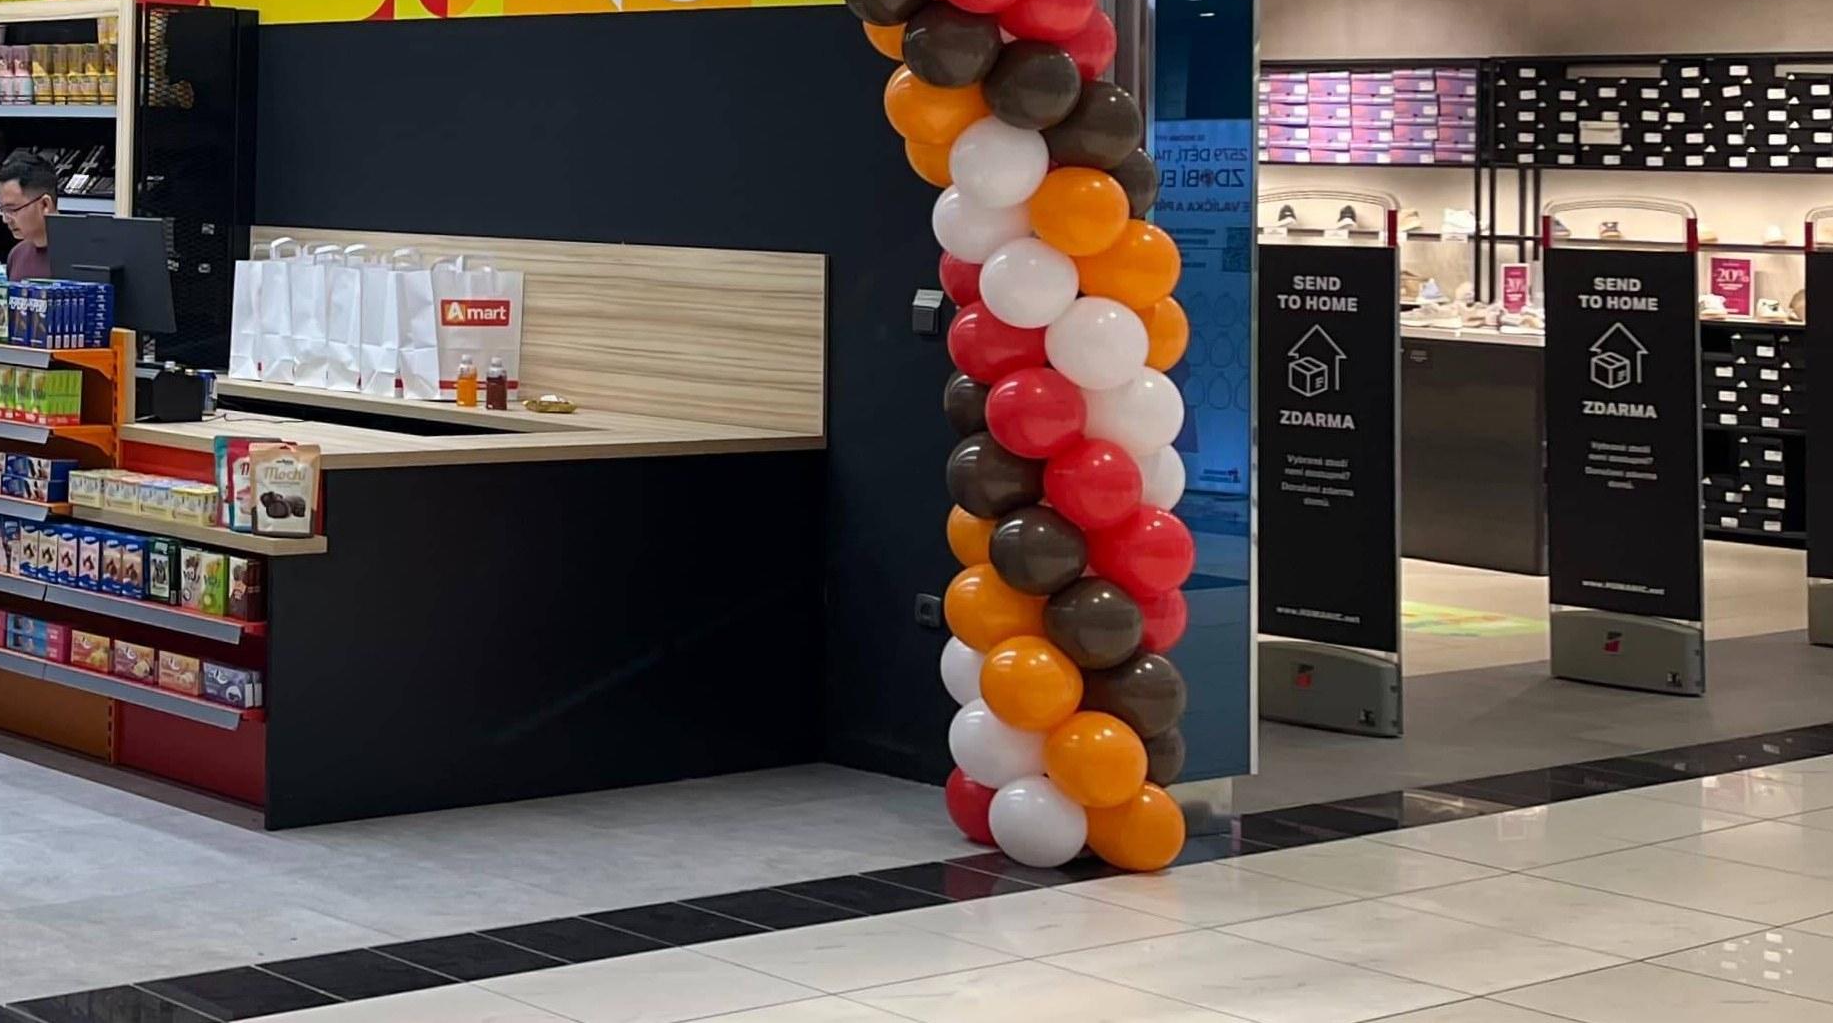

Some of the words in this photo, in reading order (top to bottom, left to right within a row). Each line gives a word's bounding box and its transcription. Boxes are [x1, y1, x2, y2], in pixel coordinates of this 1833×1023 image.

[1292, 275, 1341, 291] SEND
[1593, 276, 1642, 292] SEND
[1277, 294, 1302, 310] TO
[1305, 295, 1358, 312] HOME
[1578, 294, 1603, 309] TO
[1606, 295, 1659, 312] HOME
[1582, 400, 1658, 419] ZDARMA
[1280, 410, 1355, 430] ZDARMA
